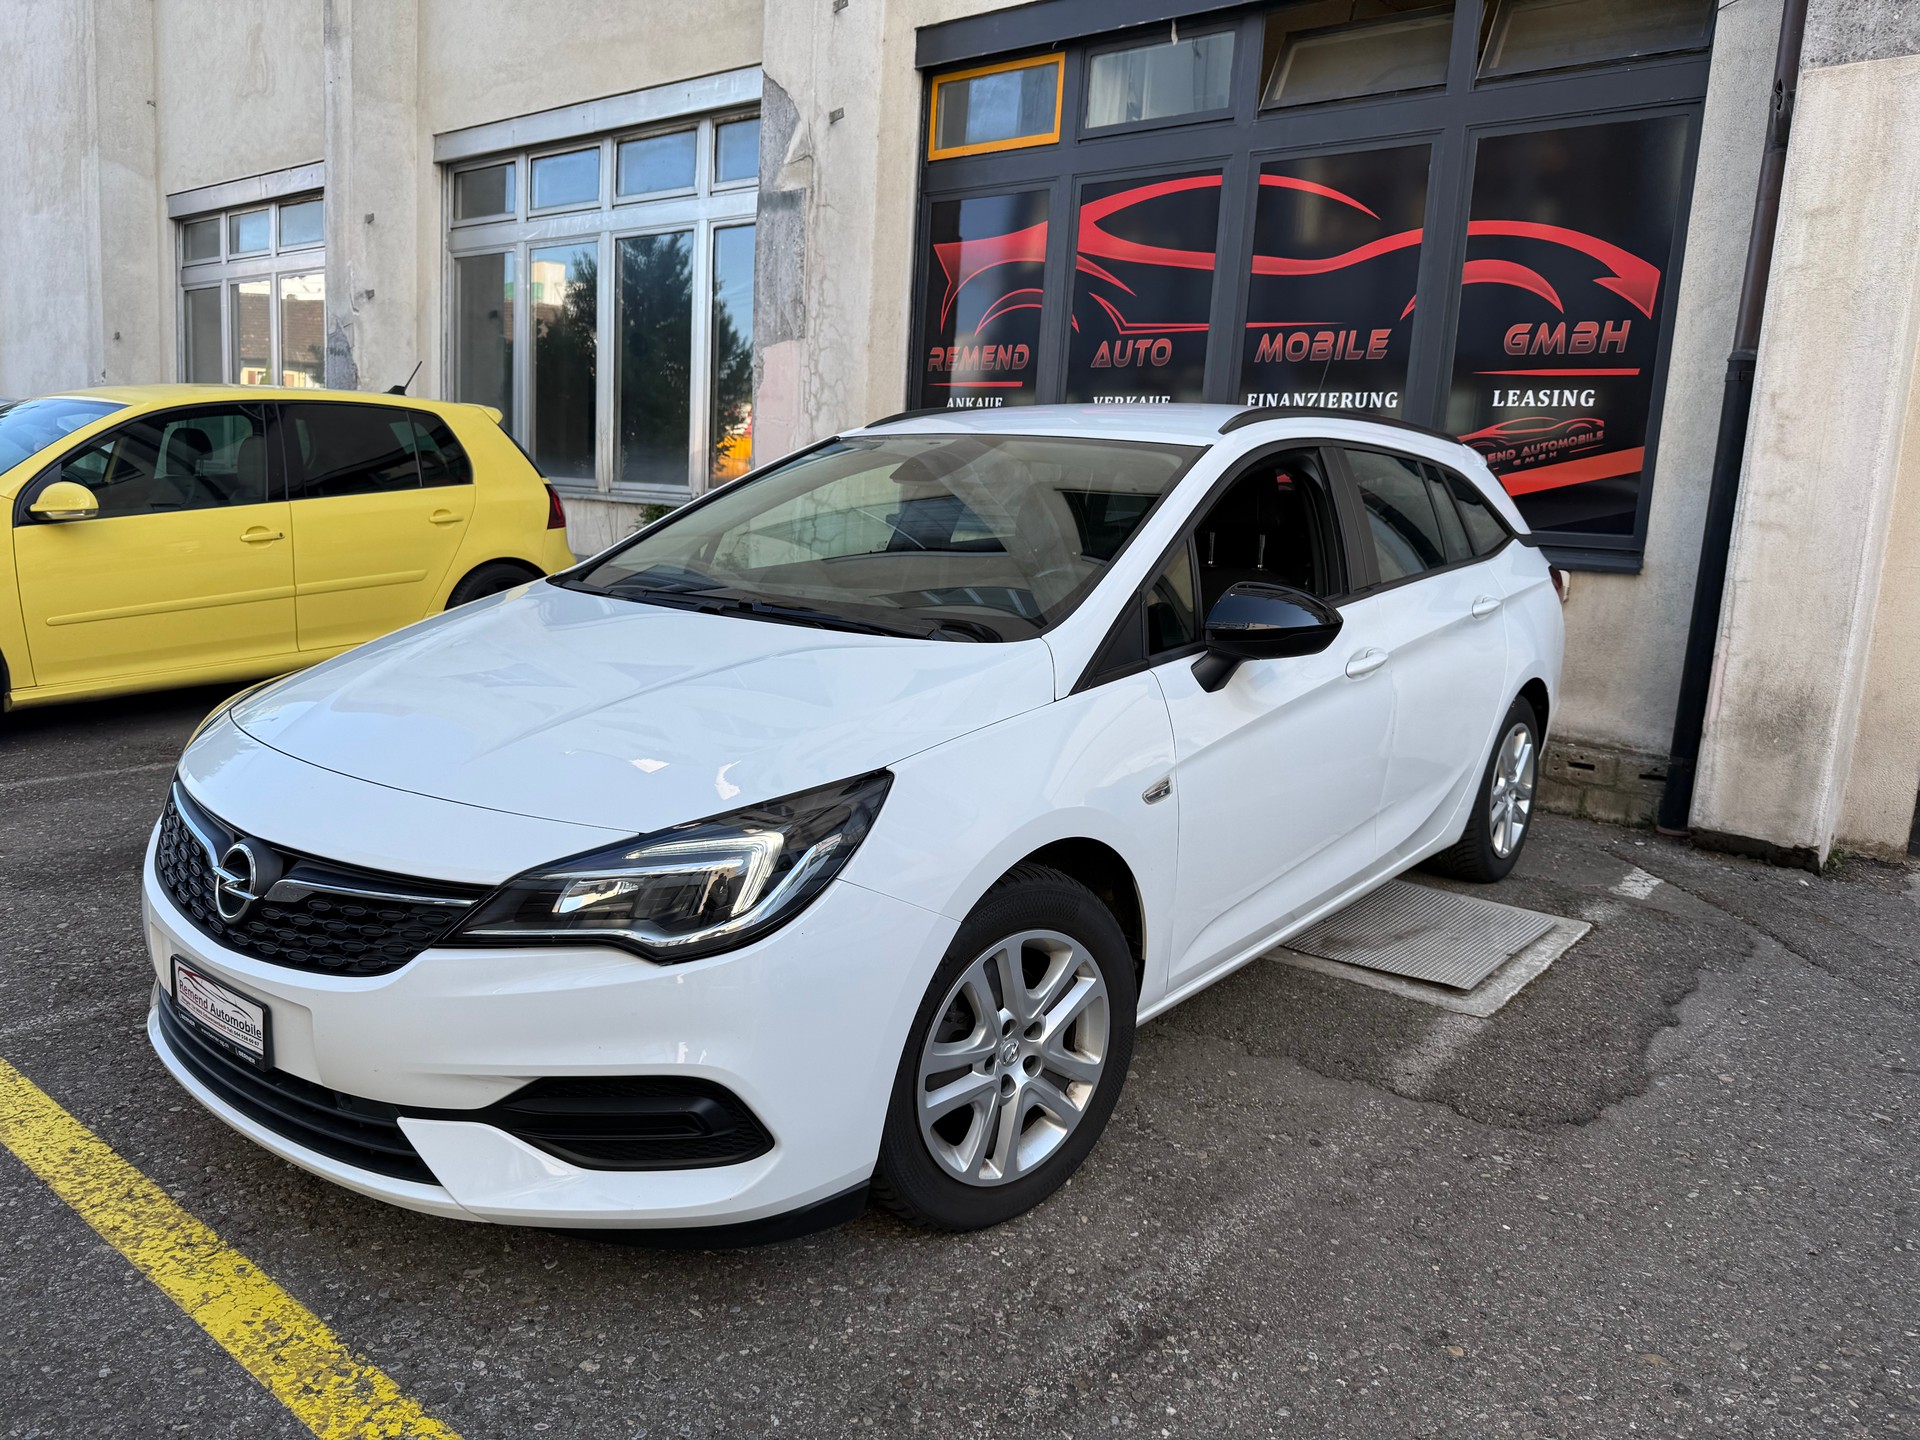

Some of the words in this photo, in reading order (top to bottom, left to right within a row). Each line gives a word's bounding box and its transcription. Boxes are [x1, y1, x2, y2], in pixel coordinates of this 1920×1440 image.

[928, 343, 1030, 372] REMEND
[1090, 337, 1172, 368] AUTO
[1254, 328, 1392, 363] MOBILE
[1503, 319, 1632, 356] GMBH
[946, 396, 1003, 409] ANKAUF
[1246, 391, 1399, 409] FINANZIERUNG
[1492, 388, 1596, 408] LEASING
[1521, 430, 1605, 457] AUTOMOBILE
[179, 979, 209, 1010] Remend
[210, 1002, 262, 1039] Automobile
